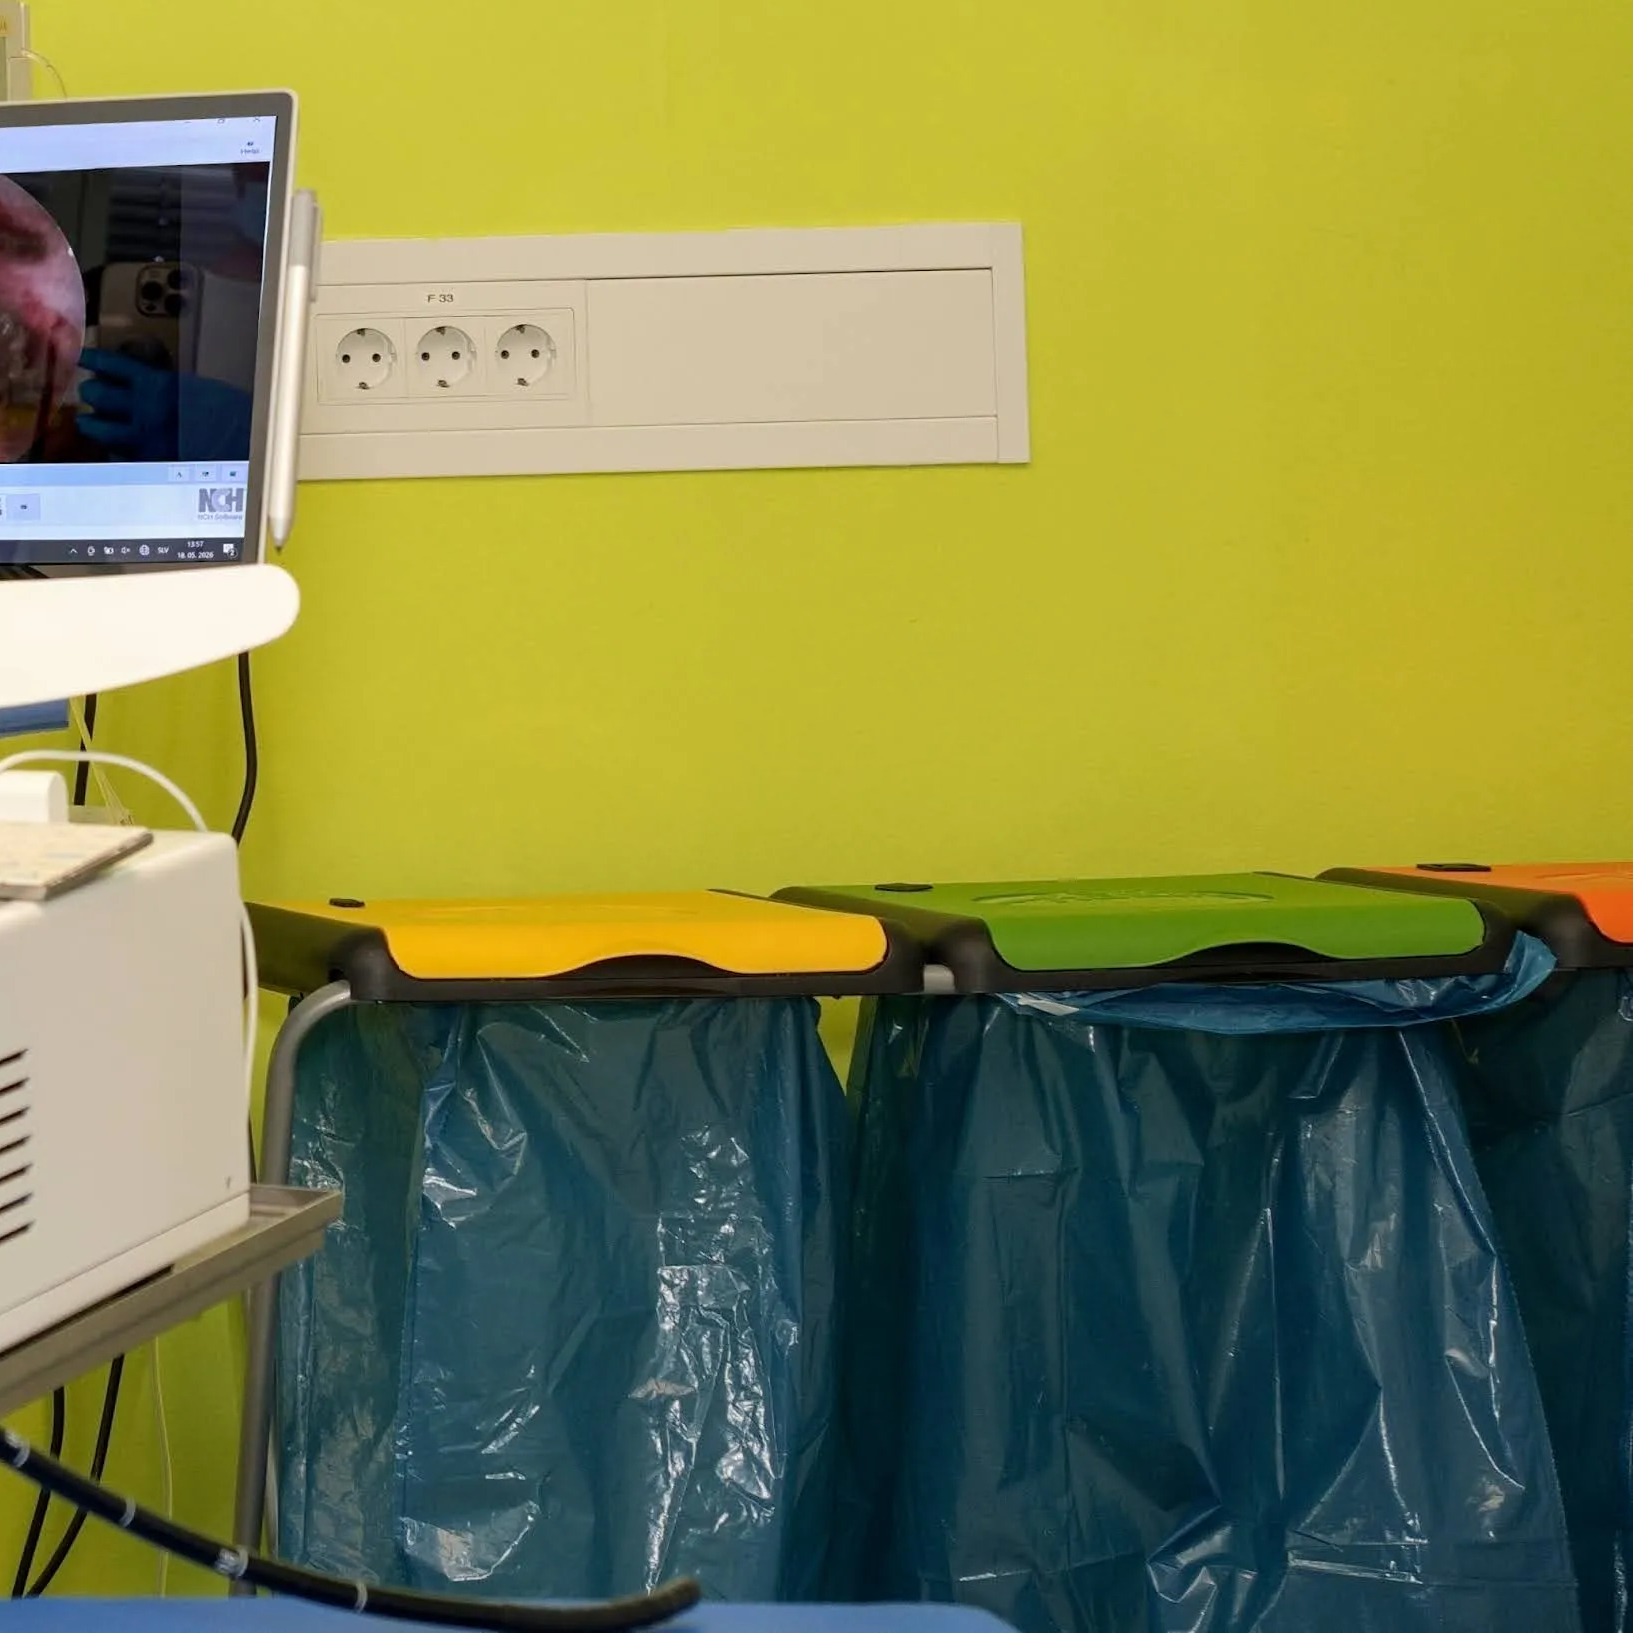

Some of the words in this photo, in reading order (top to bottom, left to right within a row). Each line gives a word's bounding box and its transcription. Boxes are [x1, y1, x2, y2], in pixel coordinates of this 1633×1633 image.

[427, 294, 436, 303] F
[439, 294, 454, 303] 33
[198, 487, 245, 513] NCH
[187, 540, 204, 548] 13:57
[157, 546, 169, 554] SLV
